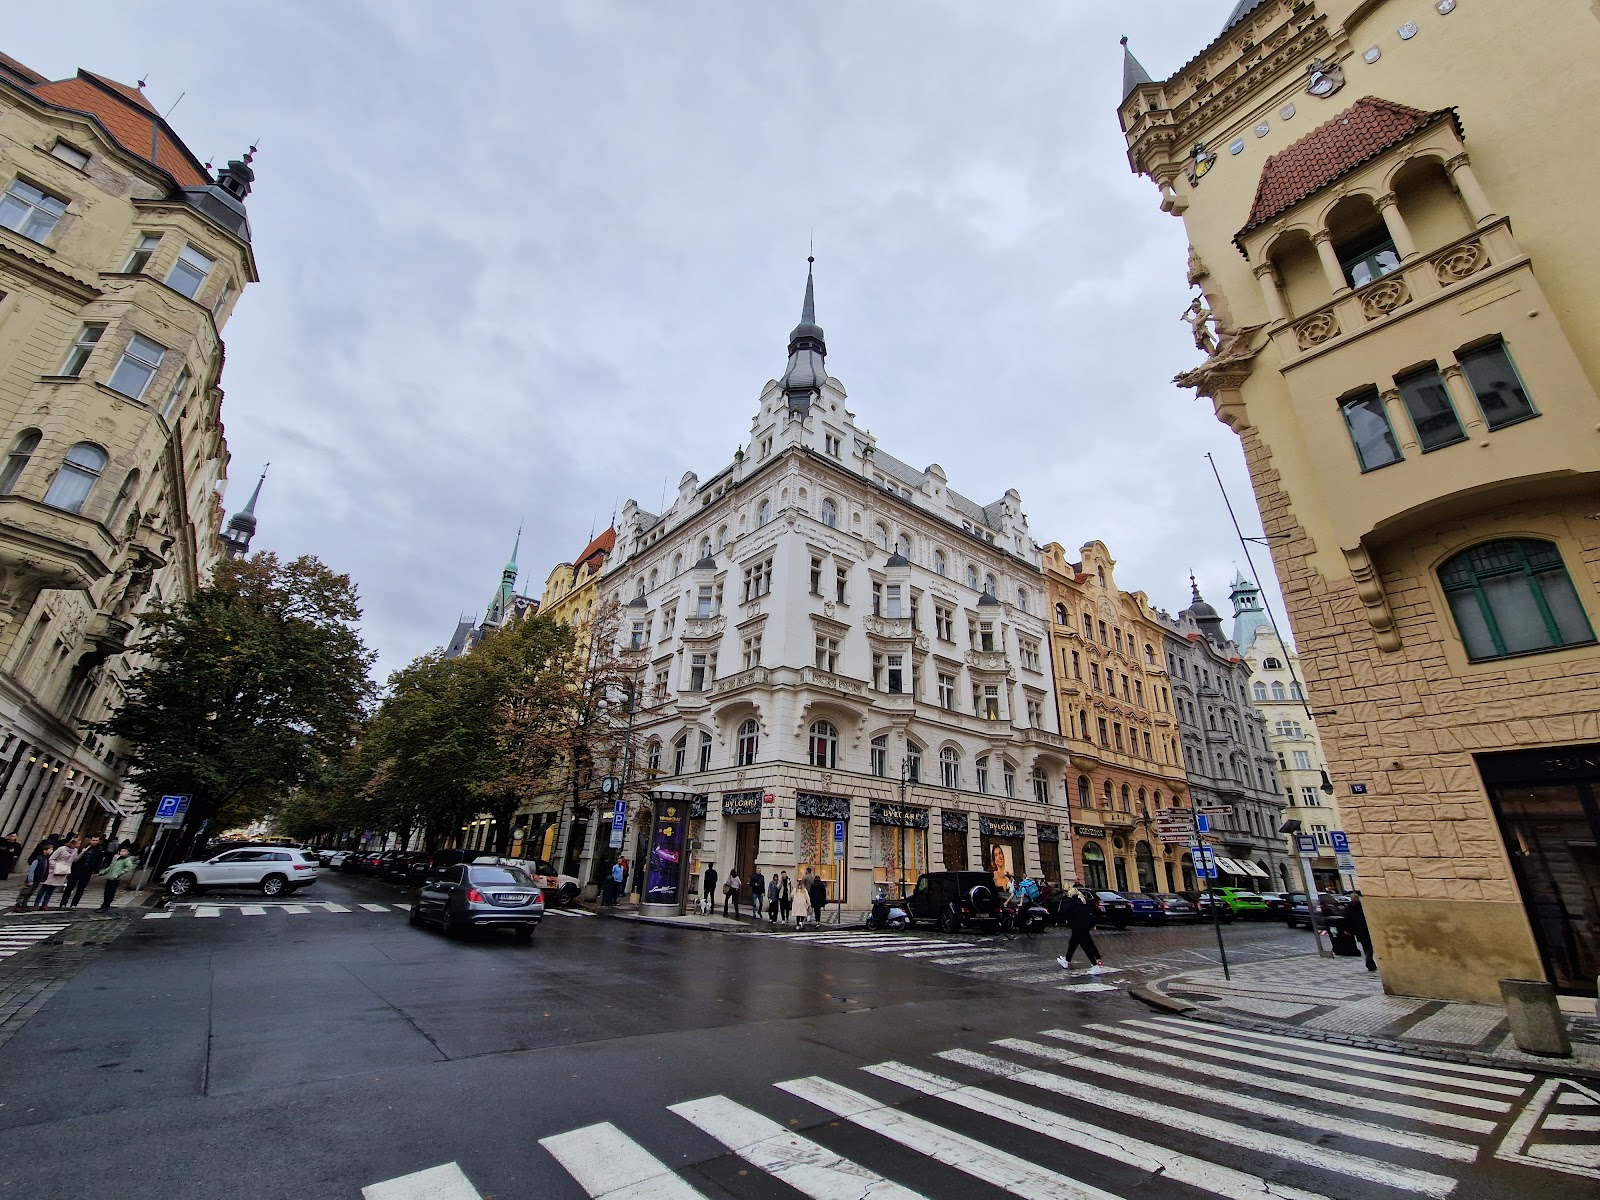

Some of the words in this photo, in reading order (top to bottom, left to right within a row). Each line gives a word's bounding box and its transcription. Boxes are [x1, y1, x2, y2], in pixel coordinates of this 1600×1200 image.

[162, 798, 175, 810] P
[725, 799, 757, 808] BVLGARI
[615, 814, 622, 825] P
[835, 823, 842, 835] P
[989, 822, 1017, 832] BVLGARI
[1333, 833, 1344, 846] P
